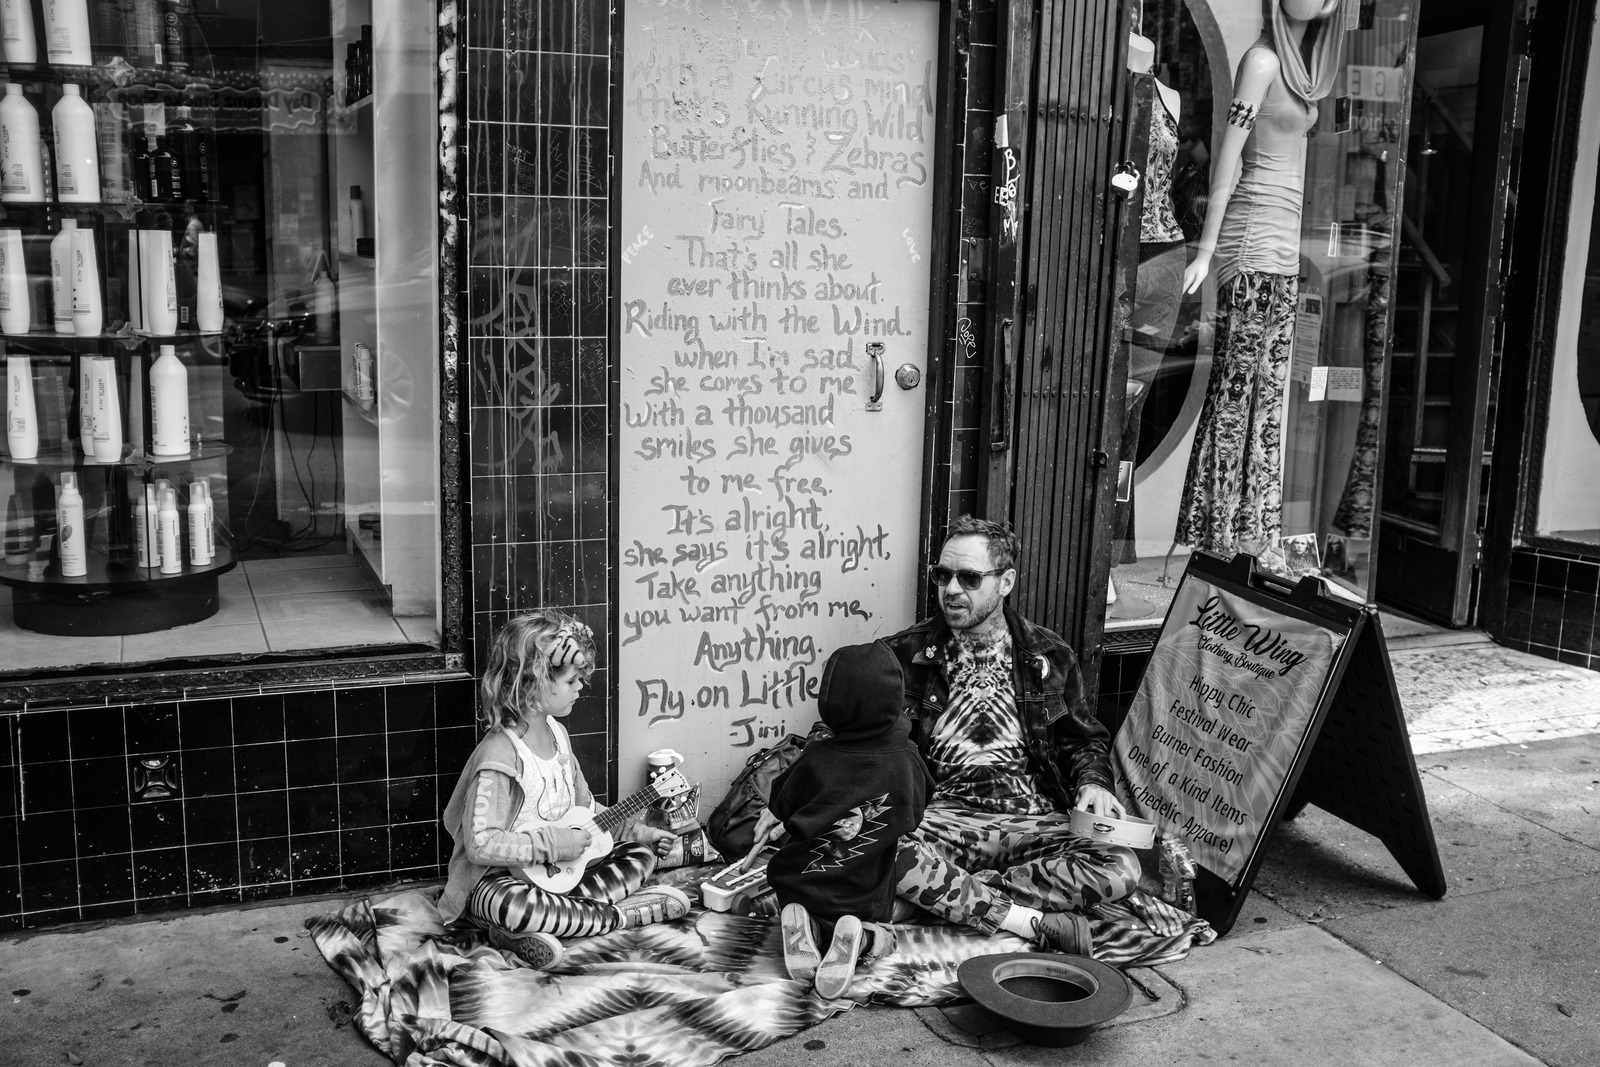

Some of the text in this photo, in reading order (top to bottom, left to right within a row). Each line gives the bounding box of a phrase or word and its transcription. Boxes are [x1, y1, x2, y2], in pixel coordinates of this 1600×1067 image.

[639, 159, 683, 197] And
[849, 171, 890, 201] and
[708, 198, 766, 242] Fairy
[769, 240, 799, 271] all
[807, 243, 853, 271] she
[667, 277, 721, 298] ever
[727, 271, 807, 300] thinks
[624, 299, 699, 345] Riding
[709, 301, 768, 333] with
[778, 305, 820, 334] the
[674, 338, 738, 370] when
[800, 337, 860, 373] sad
[644, 366, 857, 398] she comes to me
[624, 392, 835, 429] With a thousand
[635, 426, 853, 470] smiles she gives
[680, 461, 833, 502] to me free.
[661, 504, 714, 535] It's
[623, 540, 669, 566] she
[672, 541, 728, 573] says
[745, 530, 790, 562] it's
[636, 561, 822, 605] Take anything
[621, 610, 671, 647] you
[678, 598, 746, 624] want
[754, 595, 819, 631] from
[1189, 596, 1308, 676] Little Wing
[1197, 634, 1276, 680] Clothing Boutique
[635, 666, 819, 728] Fly on Little
[1189, 675, 1256, 719] Hippy Chic
[1169, 699, 1252, 752] Festival Wear
[1152, 725, 1244, 786] Burner Fashion
[1128, 745, 1247, 825] One of a Kind Items
[1182, 816, 1233, 854] Apparel
